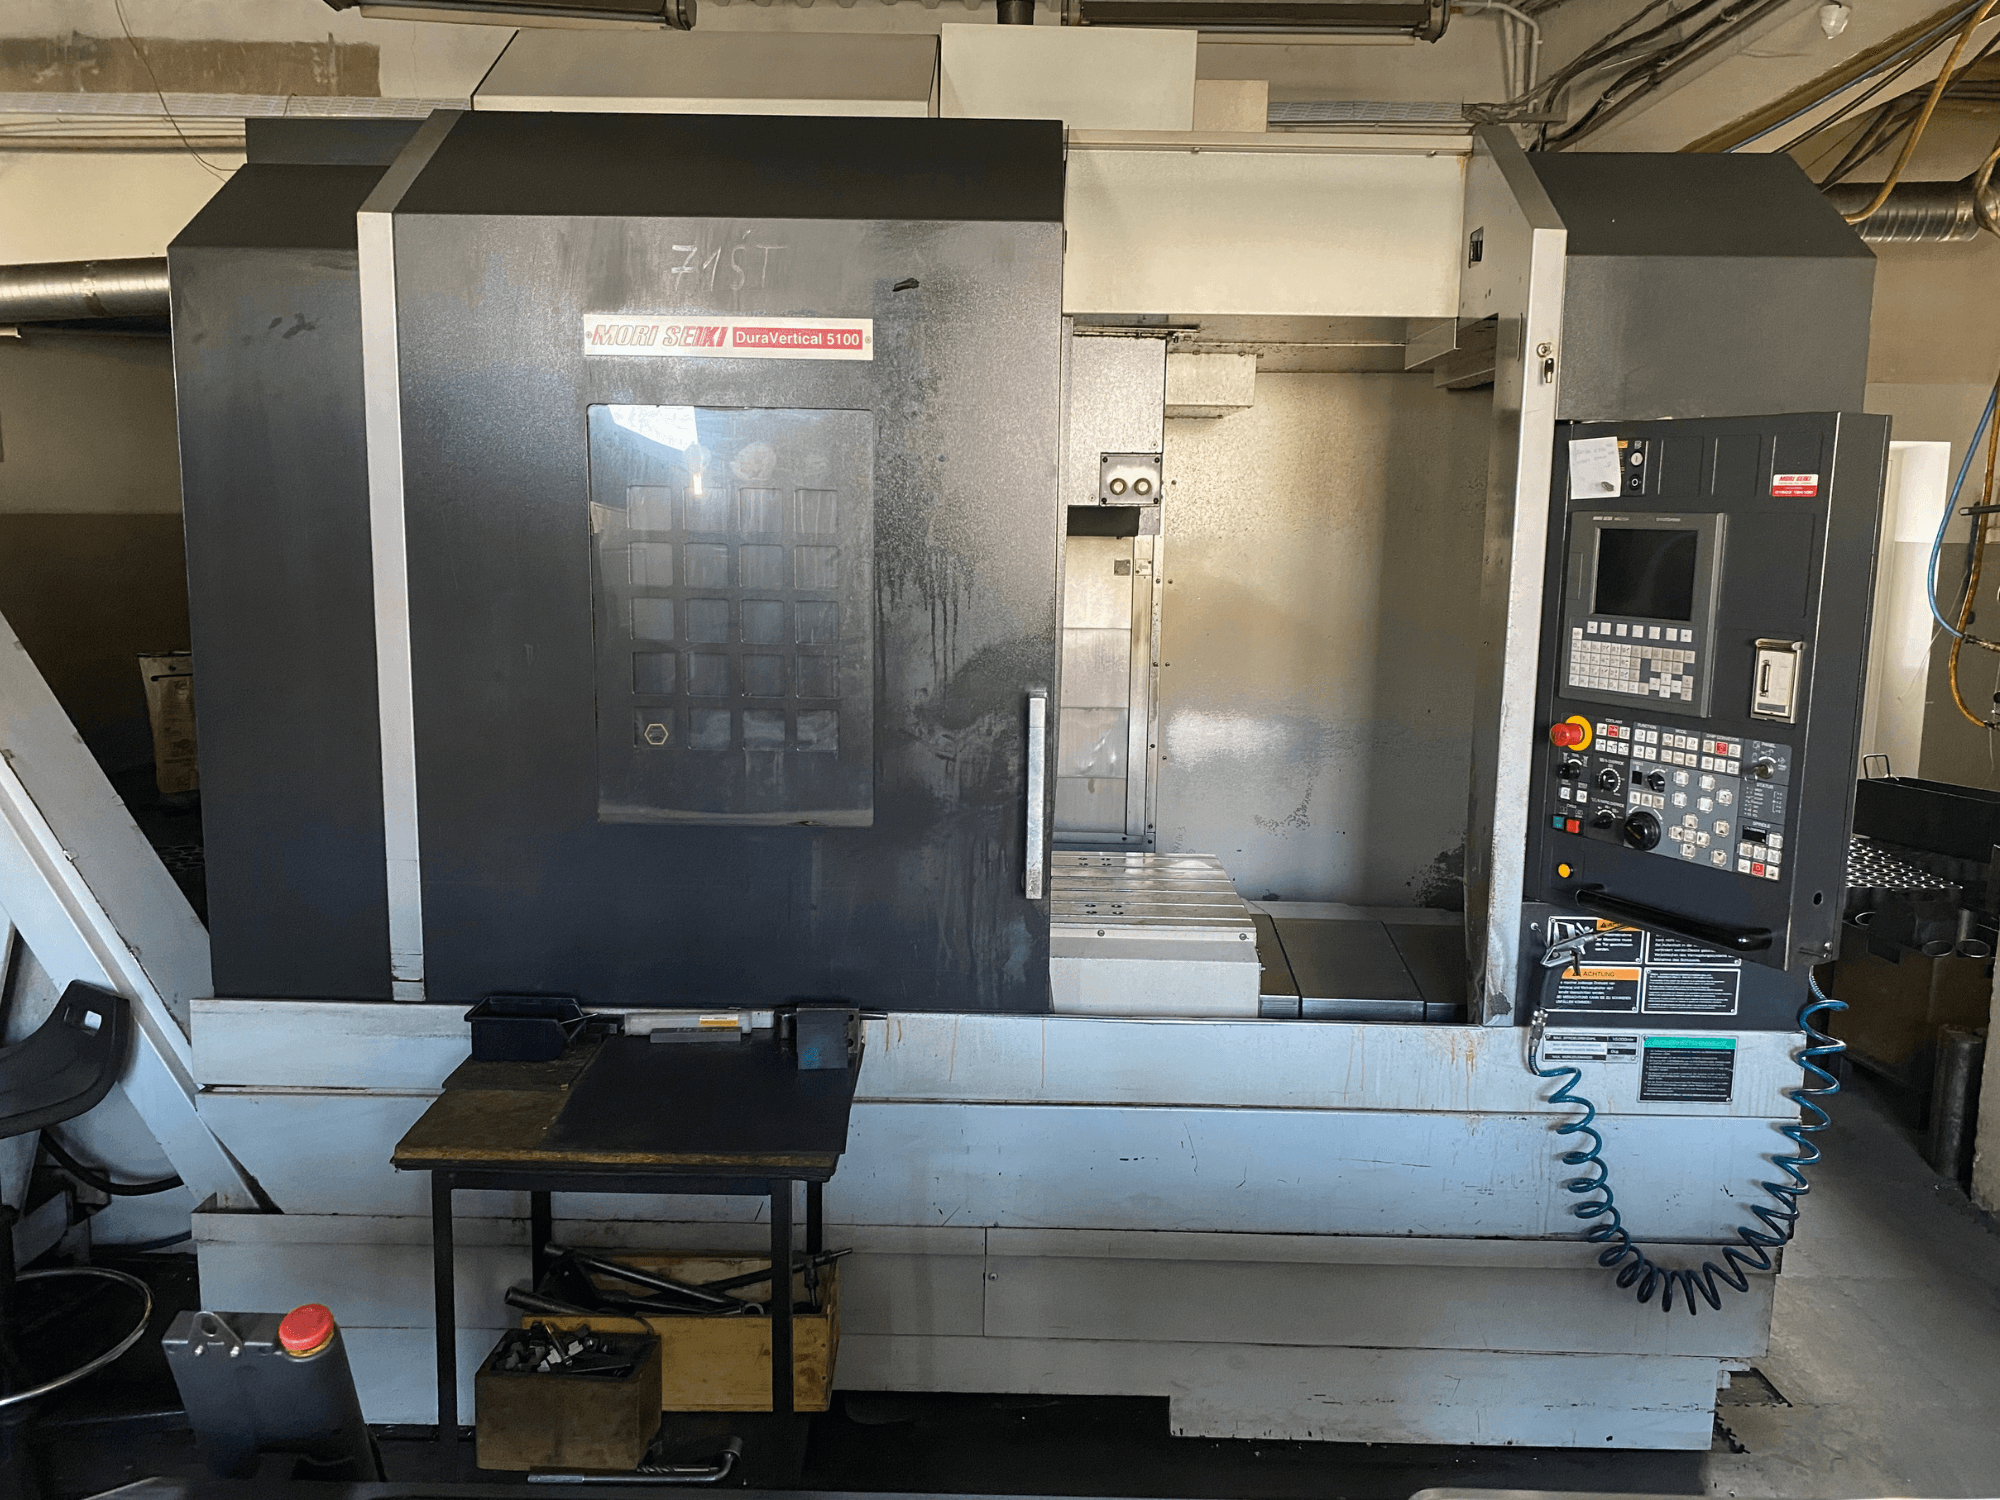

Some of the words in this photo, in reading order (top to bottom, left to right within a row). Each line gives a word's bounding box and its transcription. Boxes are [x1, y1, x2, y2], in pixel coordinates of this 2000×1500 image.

[591, 324, 659, 346] MORI
[662, 325, 729, 347] SEIKI
[736, 331, 822, 345] DuraVertical
[826, 333, 860, 346] 5100
[1752, 821, 1771, 829] SPINDLE
